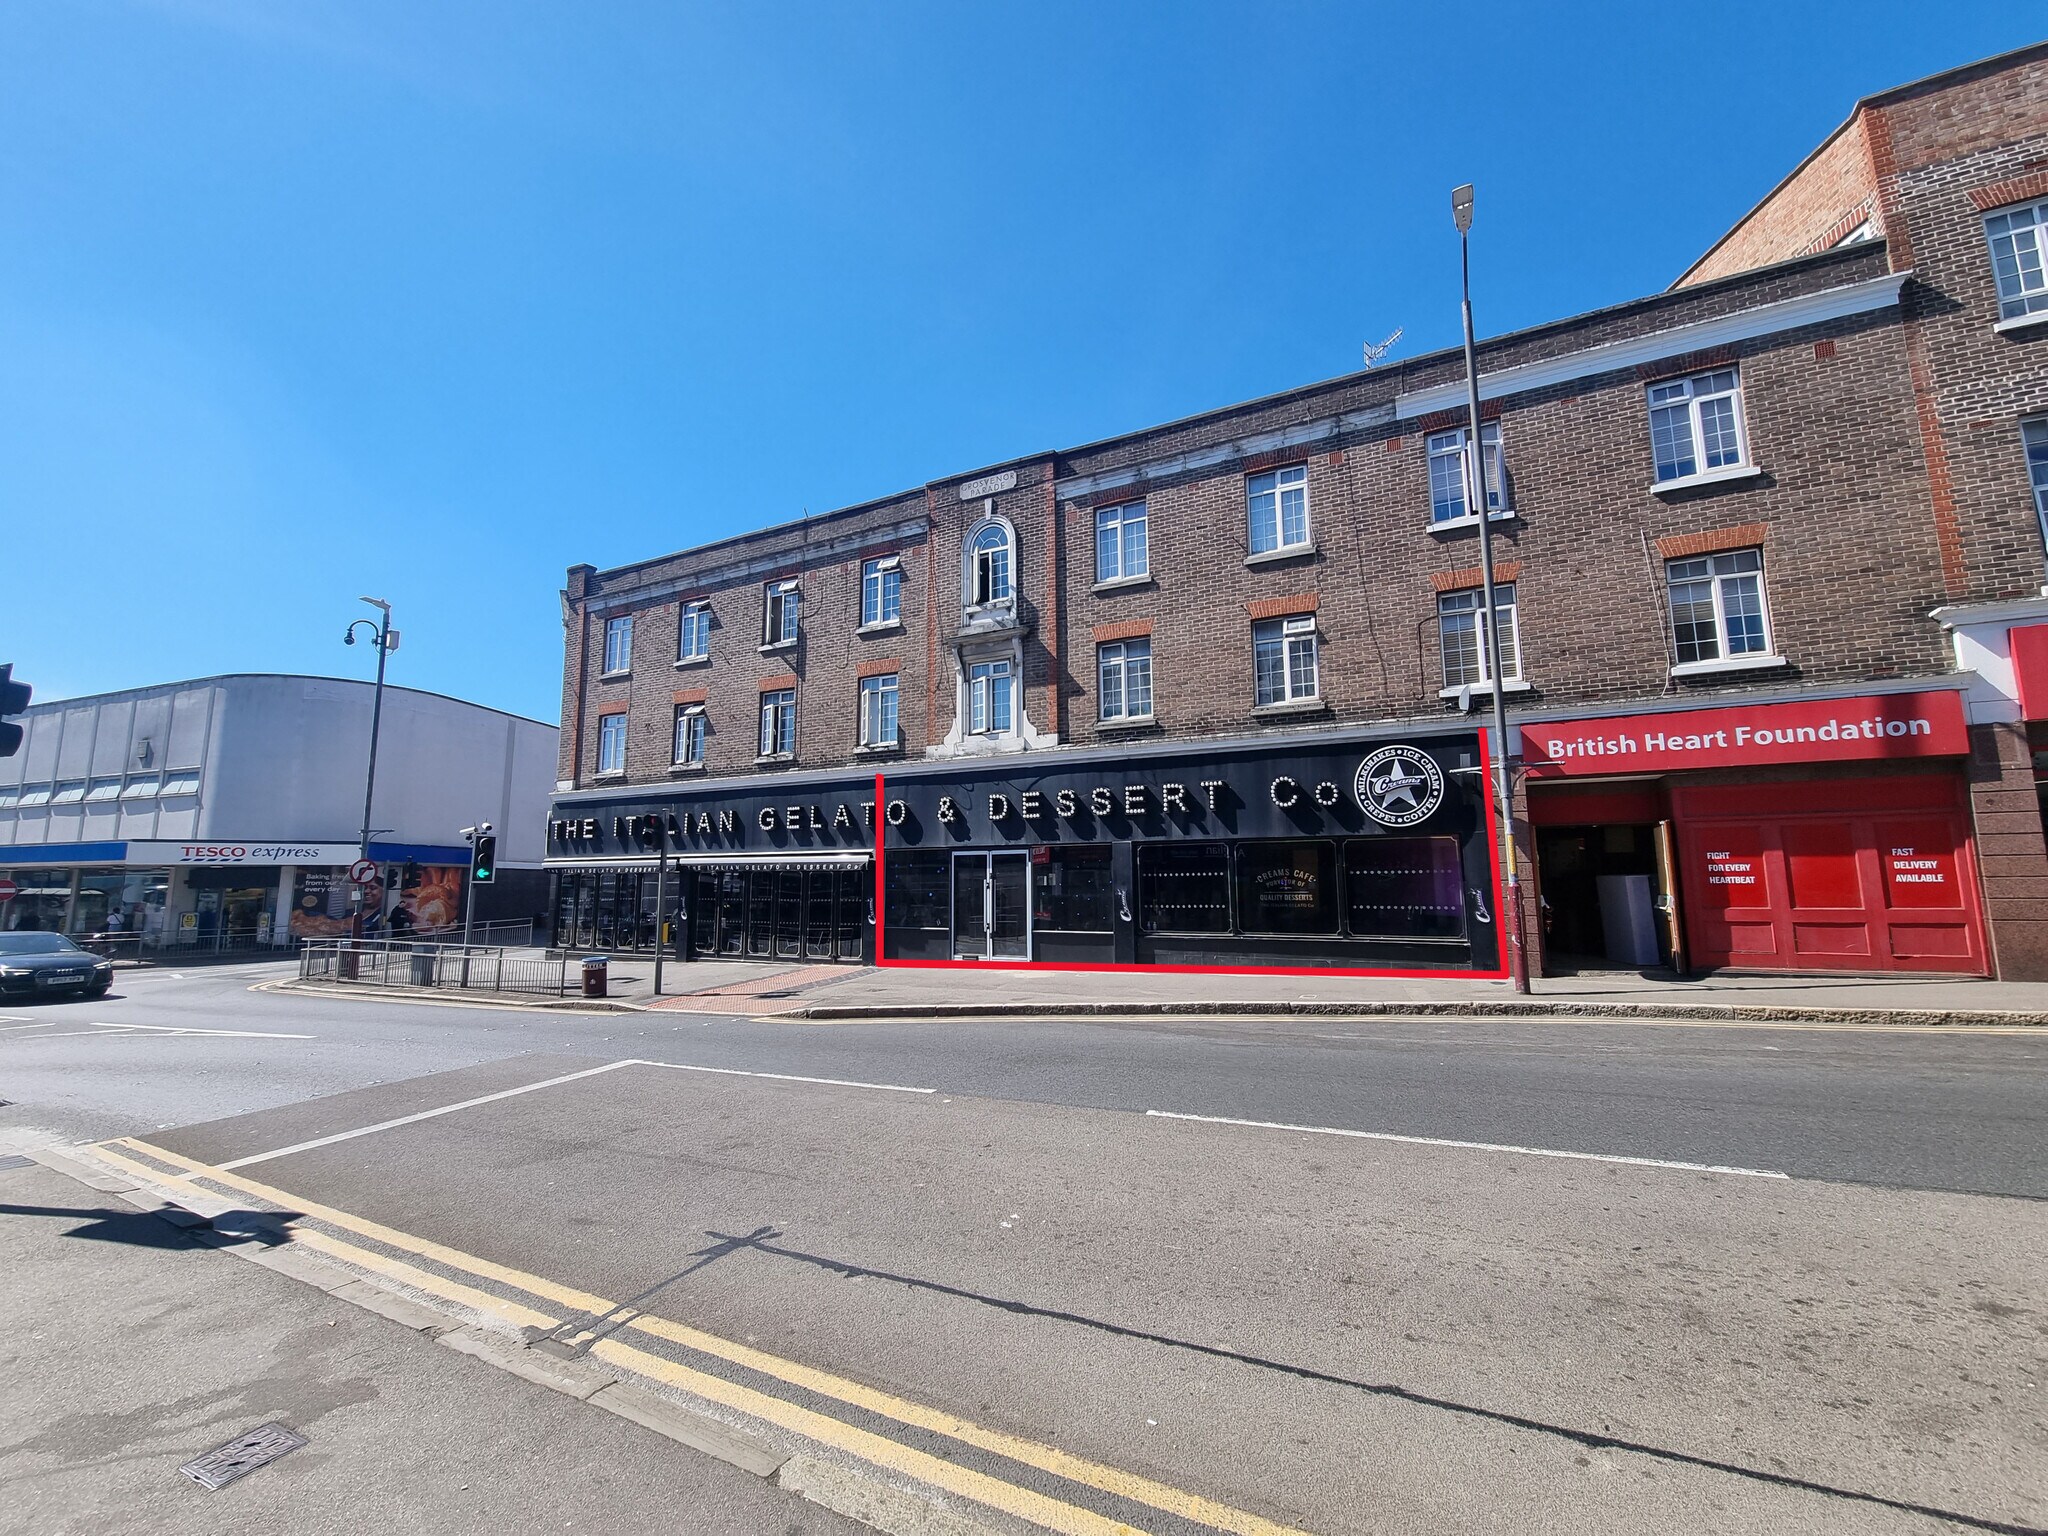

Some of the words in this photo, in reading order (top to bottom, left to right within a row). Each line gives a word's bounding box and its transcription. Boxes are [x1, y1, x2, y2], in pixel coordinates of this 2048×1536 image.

[961, 472, 1015, 492] GROSVENOR
[970, 482, 1006, 497] PARADE
[1547, 735, 1637, 760] British
[1645, 730, 1728, 752] Heart
[1736, 716, 1931, 747] Foundation
[1358, 749, 1396, 793] MILKSHAKES
[1403, 749, 1421, 761] ICE
[1420, 758, 1440, 790] CREAM
[551, 818, 594, 840] THE
[613, 810, 733, 837] ITIAN
[758, 799, 906, 831] GELATO
[937, 796, 955, 823] &
[988, 780, 1223, 821] DESSERT
[1363, 800, 1396, 823] CREPES
[1403, 796, 1437, 822] COFFEE
[181, 846, 246, 857] TESCO
[251, 846, 320, 860] express
[1707, 852, 1730, 860] FIGHT
[1892, 848, 1914, 856] FAST
[1708, 863, 1725, 872] FOR
[1725, 863, 1751, 872] EVERY
[1893, 860, 1938, 869] DELIVERY
[1256, 868, 1290, 883] CREAMS
[1293, 869, 1315, 882] CAFE
[1709, 875, 1755, 884] HEARTBEAT
[1895, 873, 1944, 882] AVAILABLE
